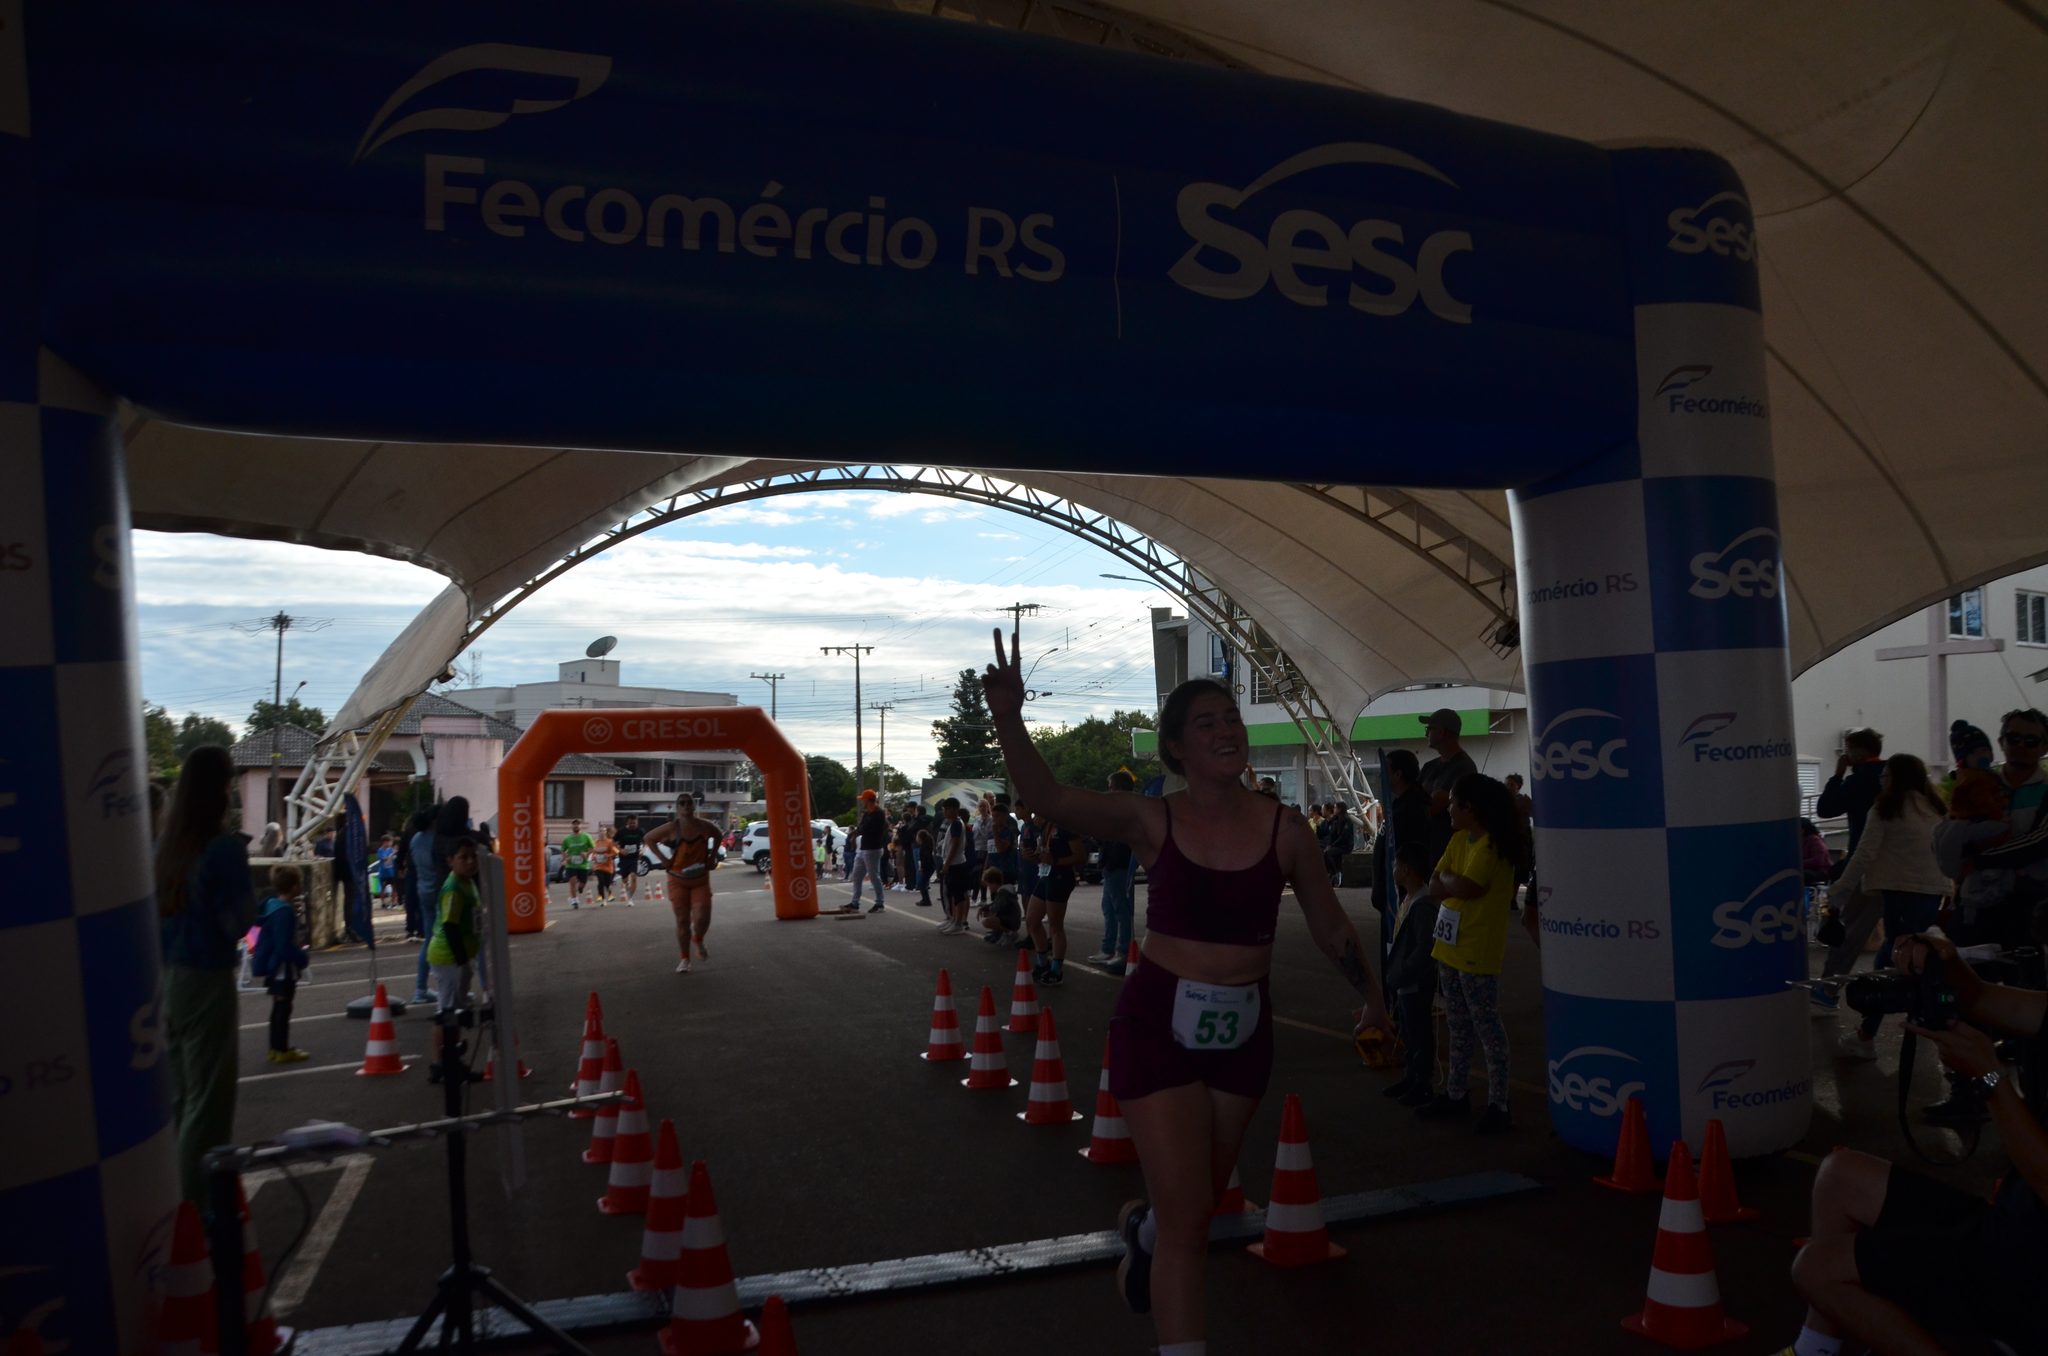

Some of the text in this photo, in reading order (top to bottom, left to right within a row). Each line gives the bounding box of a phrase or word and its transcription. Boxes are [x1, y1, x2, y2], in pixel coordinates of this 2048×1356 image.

[423, 152, 1067, 283] Fecomércio RS
[1167, 181, 1474, 325] Sesc
[1605, 572, 1639, 594] RS
[1688, 551, 1781, 600] Ses
[621, 717, 728, 741] CRESOL
[512, 794, 534, 886] CRESOL
[784, 783, 806, 871] CRESOL
[1434, 919, 1453, 940] 93
[1627, 920, 1661, 940] RS
[1195, 1010, 1239, 1044] 53
[26, 1054, 76, 1090] RS
